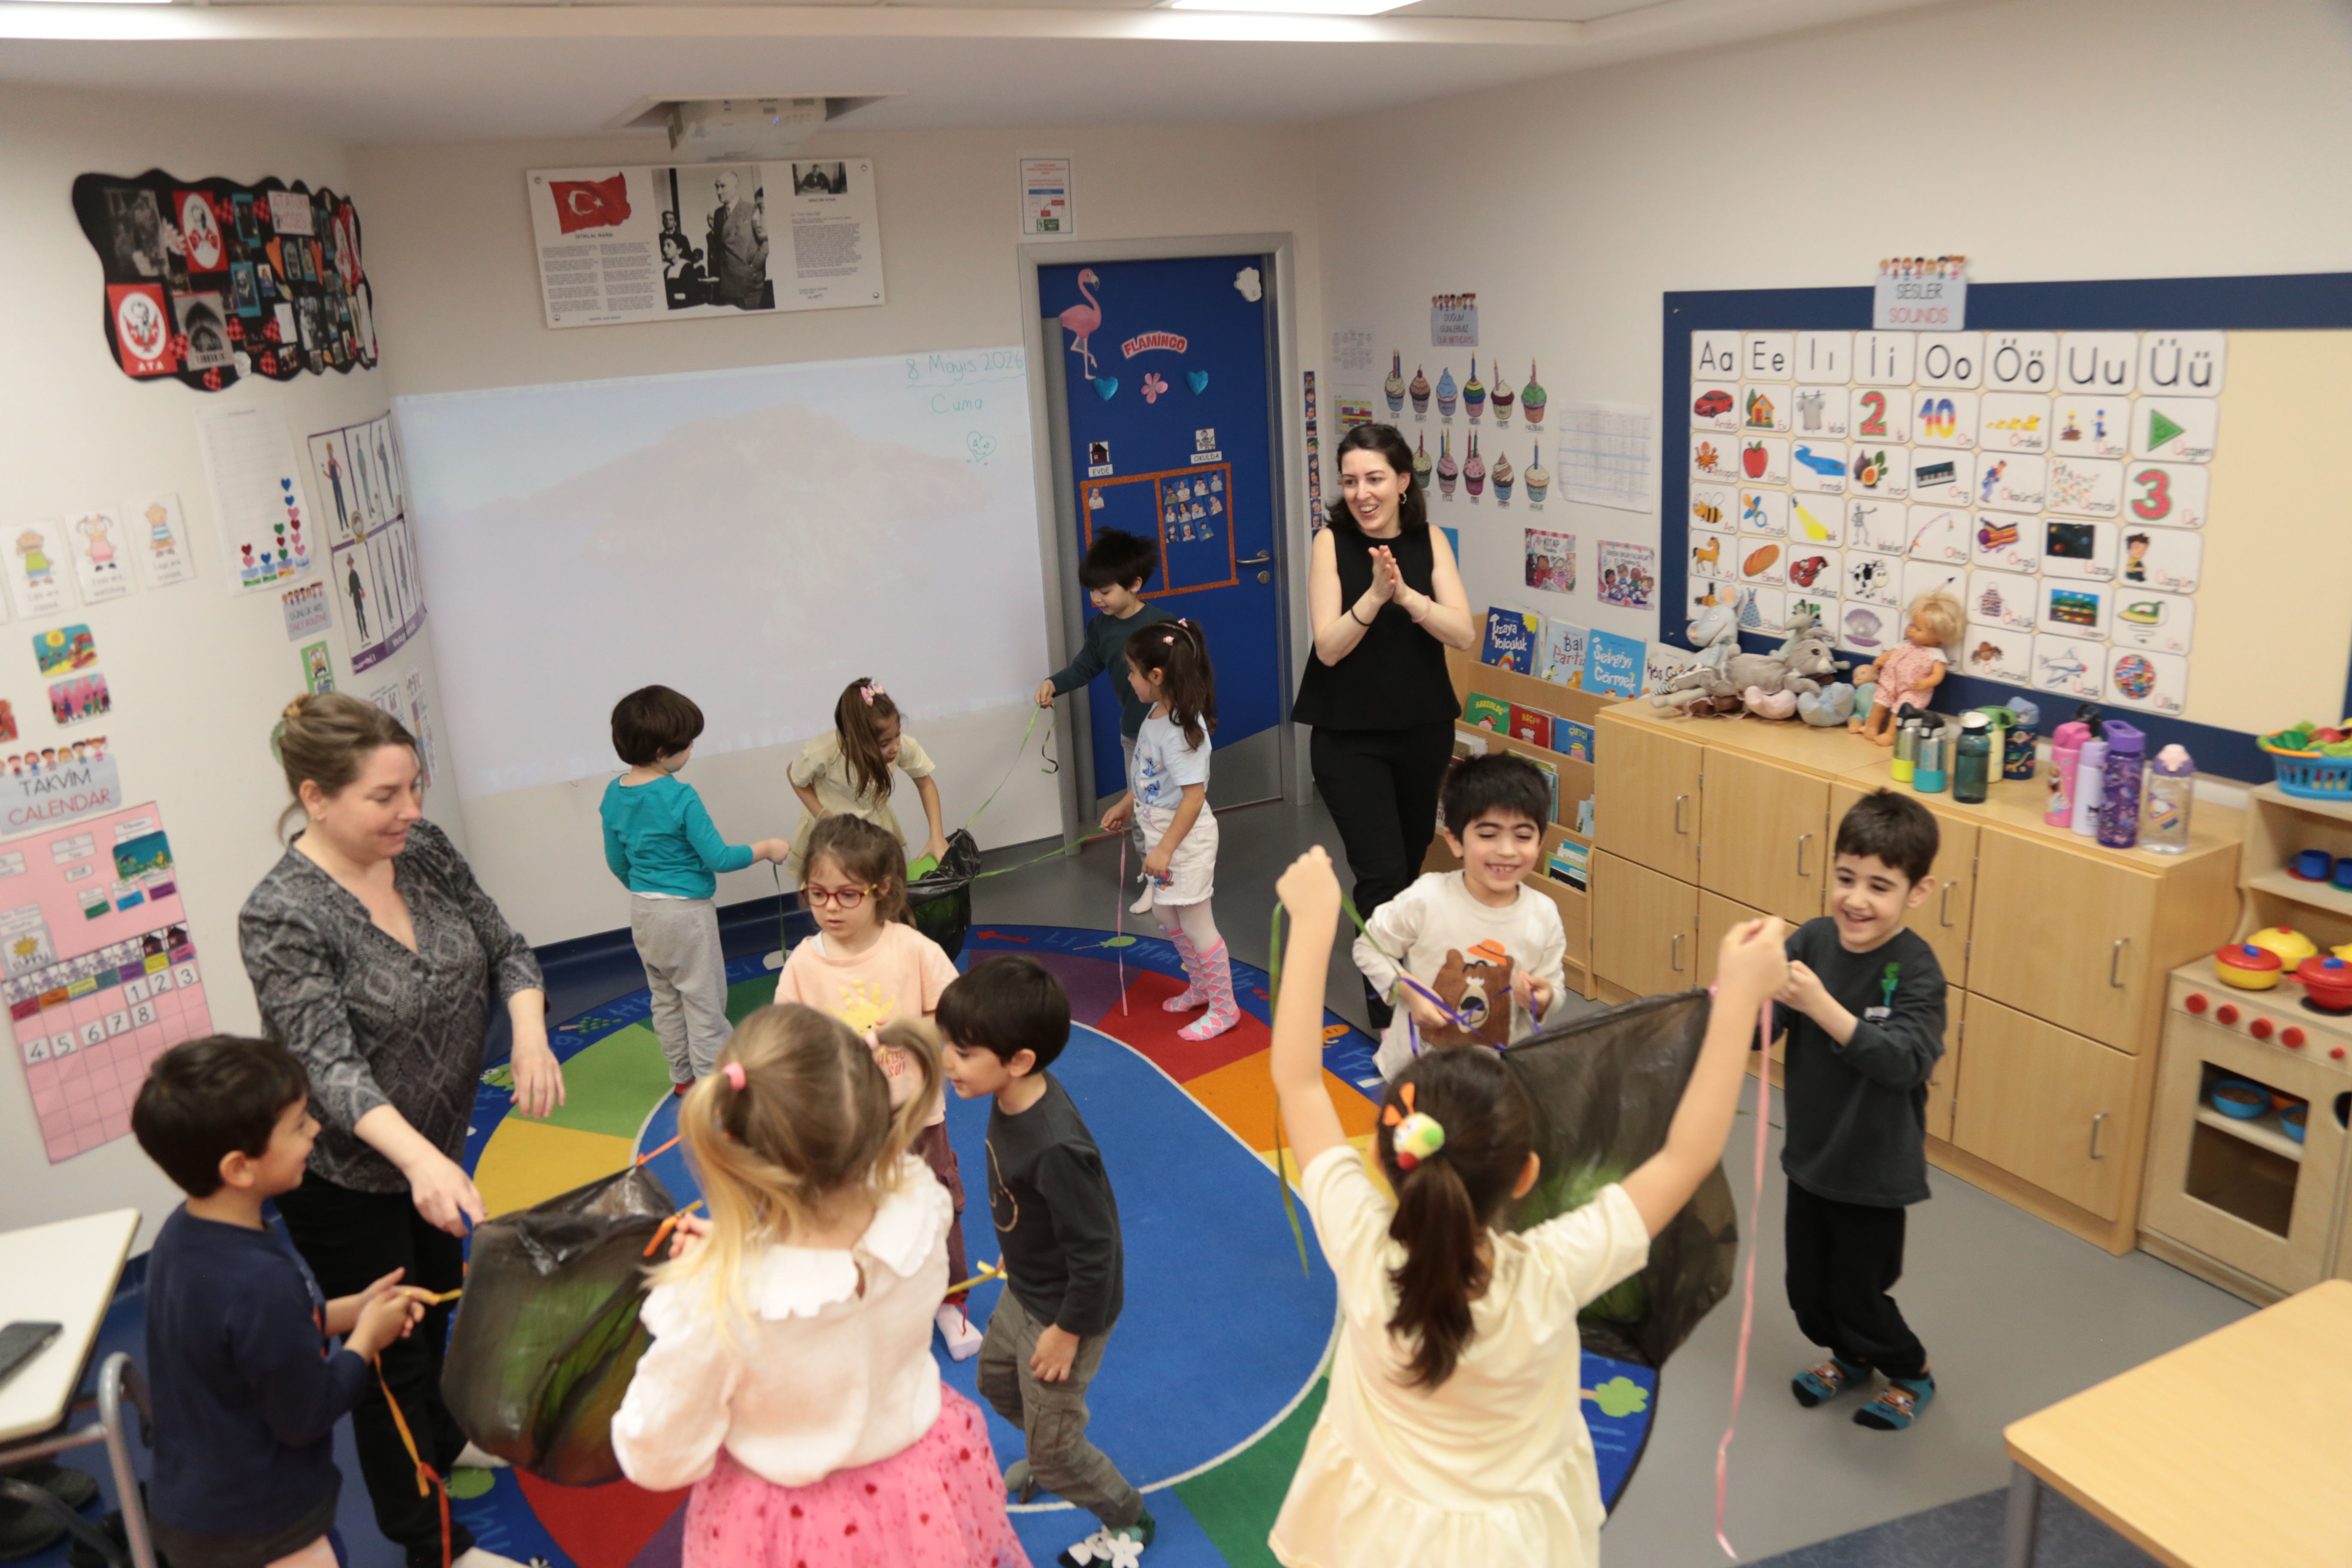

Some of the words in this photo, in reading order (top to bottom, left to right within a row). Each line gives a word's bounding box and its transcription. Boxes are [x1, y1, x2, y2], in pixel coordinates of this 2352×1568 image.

[1896, 284, 1943, 299] SESLER
[1889, 308, 1948, 324] SOUNDS
[1699, 341, 1733, 371] Aa
[1753, 341, 1784, 371] Ee
[1925, 345, 1971, 380] Oo
[1994, 338, 2044, 383] Öö
[2151, 338, 2211, 387] Üü
[138, 360, 164, 371] ATA
[906, 358, 919, 380] 8
[929, 354, 977, 381] Mayıs
[980, 350, 1023, 371] 2026
[2069, 347, 2125, 385] Uu
[931, 394, 983, 413] Cuma
[1859, 390, 1887, 437] 2
[1918, 398, 1956, 438] 10
[1715, 419, 1738, 430] Araba
[1778, 420, 1787, 430] Ev
[1957, 433, 1973, 446] On
[2010, 432, 2043, 448] Ördek
[1194, 453, 1220, 462] OKULDA
[1093, 467, 1109, 475] EVDE
[1768, 473, 1787, 483] Elma
[1820, 480, 1842, 492] Irmak
[1949, 486, 1969, 504] Org
[2131, 468, 2172, 521] 3
[1544, 537, 1559, 547] KİTAP
[1945, 546, 1966, 560] Olta
[1724, 570, 1734, 580] At
[1762, 572, 1784, 583] Ekmek
[1493, 622, 1517, 636] Uzaya
[1492, 634, 1527, 651] Yolculuk
[1564, 637, 1583, 652] Bal
[1593, 644, 1632, 668] Sevgiyi
[1594, 665, 1636, 693] Görmek
[1476, 700, 1503, 715] ARKEOLOG
[19, 768, 92, 797] TAKVİM
[8, 787, 112, 826] CALENDAR
[154, 975, 165, 991] 2
[181, 969, 193, 984] 3
[131, 986, 139, 1001] 1
[112, 1015, 122, 1030] 7
[139, 1007, 149, 1023] 8
[89, 1026, 99, 1041] 6
[30, 1042, 44, 1059] 4
[58, 1035, 70, 1054] 5
